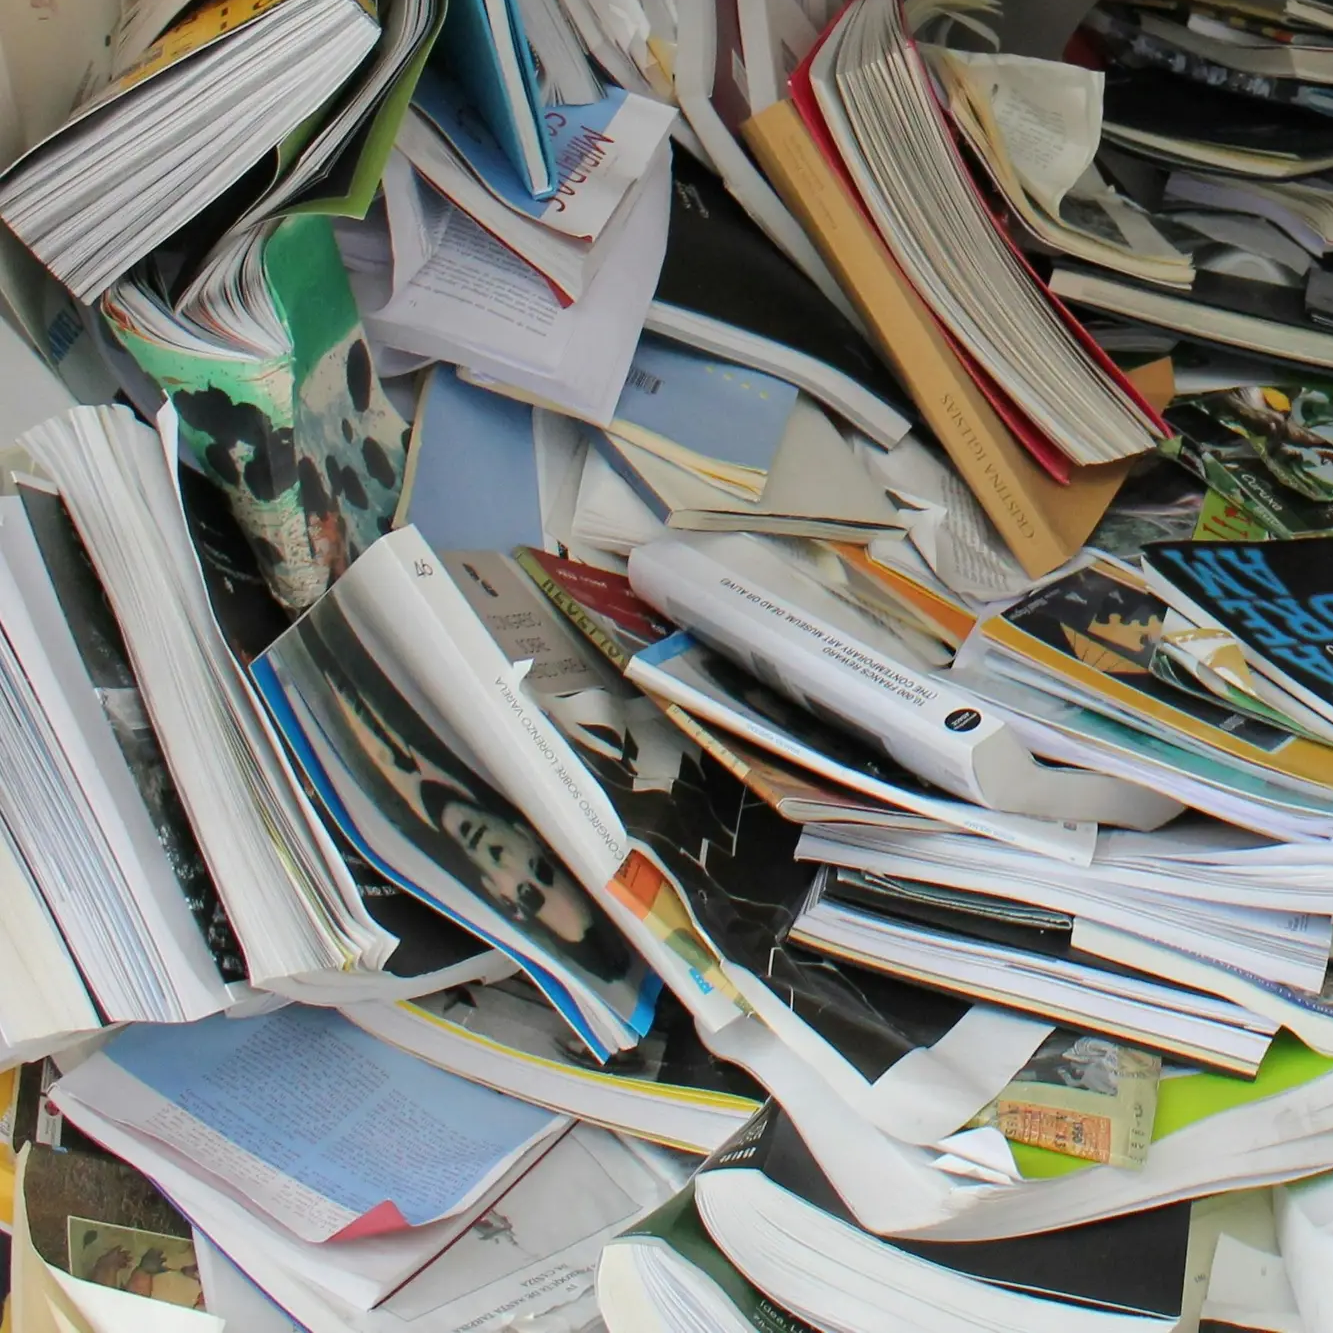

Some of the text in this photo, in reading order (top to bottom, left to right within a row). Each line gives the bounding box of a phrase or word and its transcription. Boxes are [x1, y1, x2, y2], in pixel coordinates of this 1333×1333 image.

[940, 393, 1036, 540] IGLESIAS CRISTINA
[822, 646, 866, 674] REWARD
[496, 676, 523, 717] VARELA
[521, 717, 561, 771] LORENZO
[553, 764, 581, 800] SOBRE
[577, 799, 624, 862] CONGRESO
